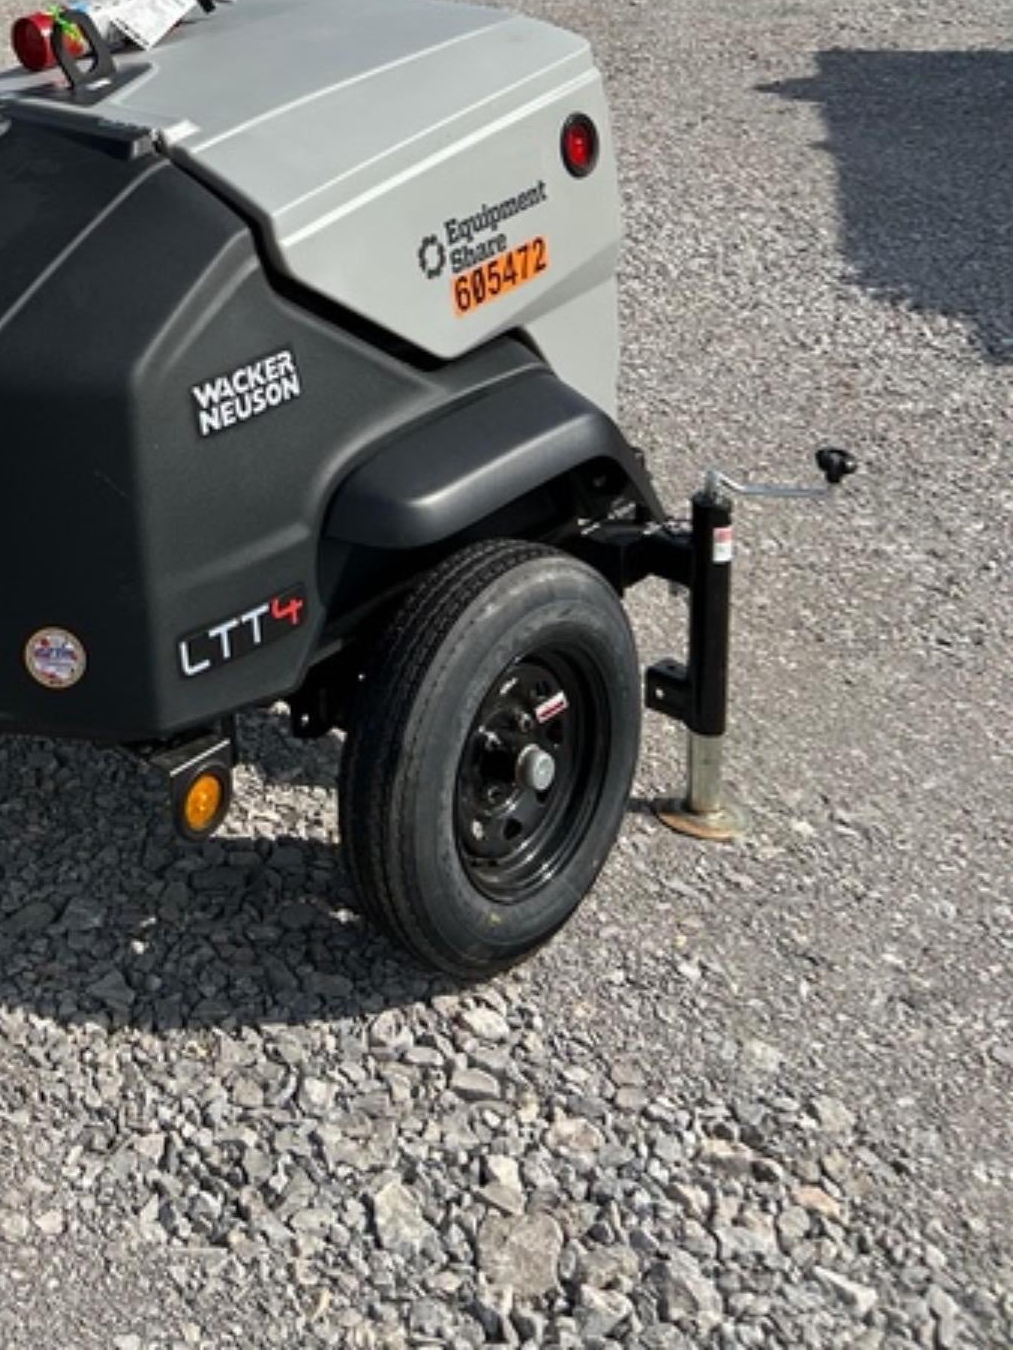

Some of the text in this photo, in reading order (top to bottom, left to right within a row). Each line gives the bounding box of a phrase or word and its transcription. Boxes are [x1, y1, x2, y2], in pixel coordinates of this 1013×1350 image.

[443, 179, 547, 246] Equipment
[449, 233, 507, 274] Share
[454, 236, 547, 312] 605472
[191, 350, 296, 410] WACKER
[198, 373, 301, 437] NEUSON
